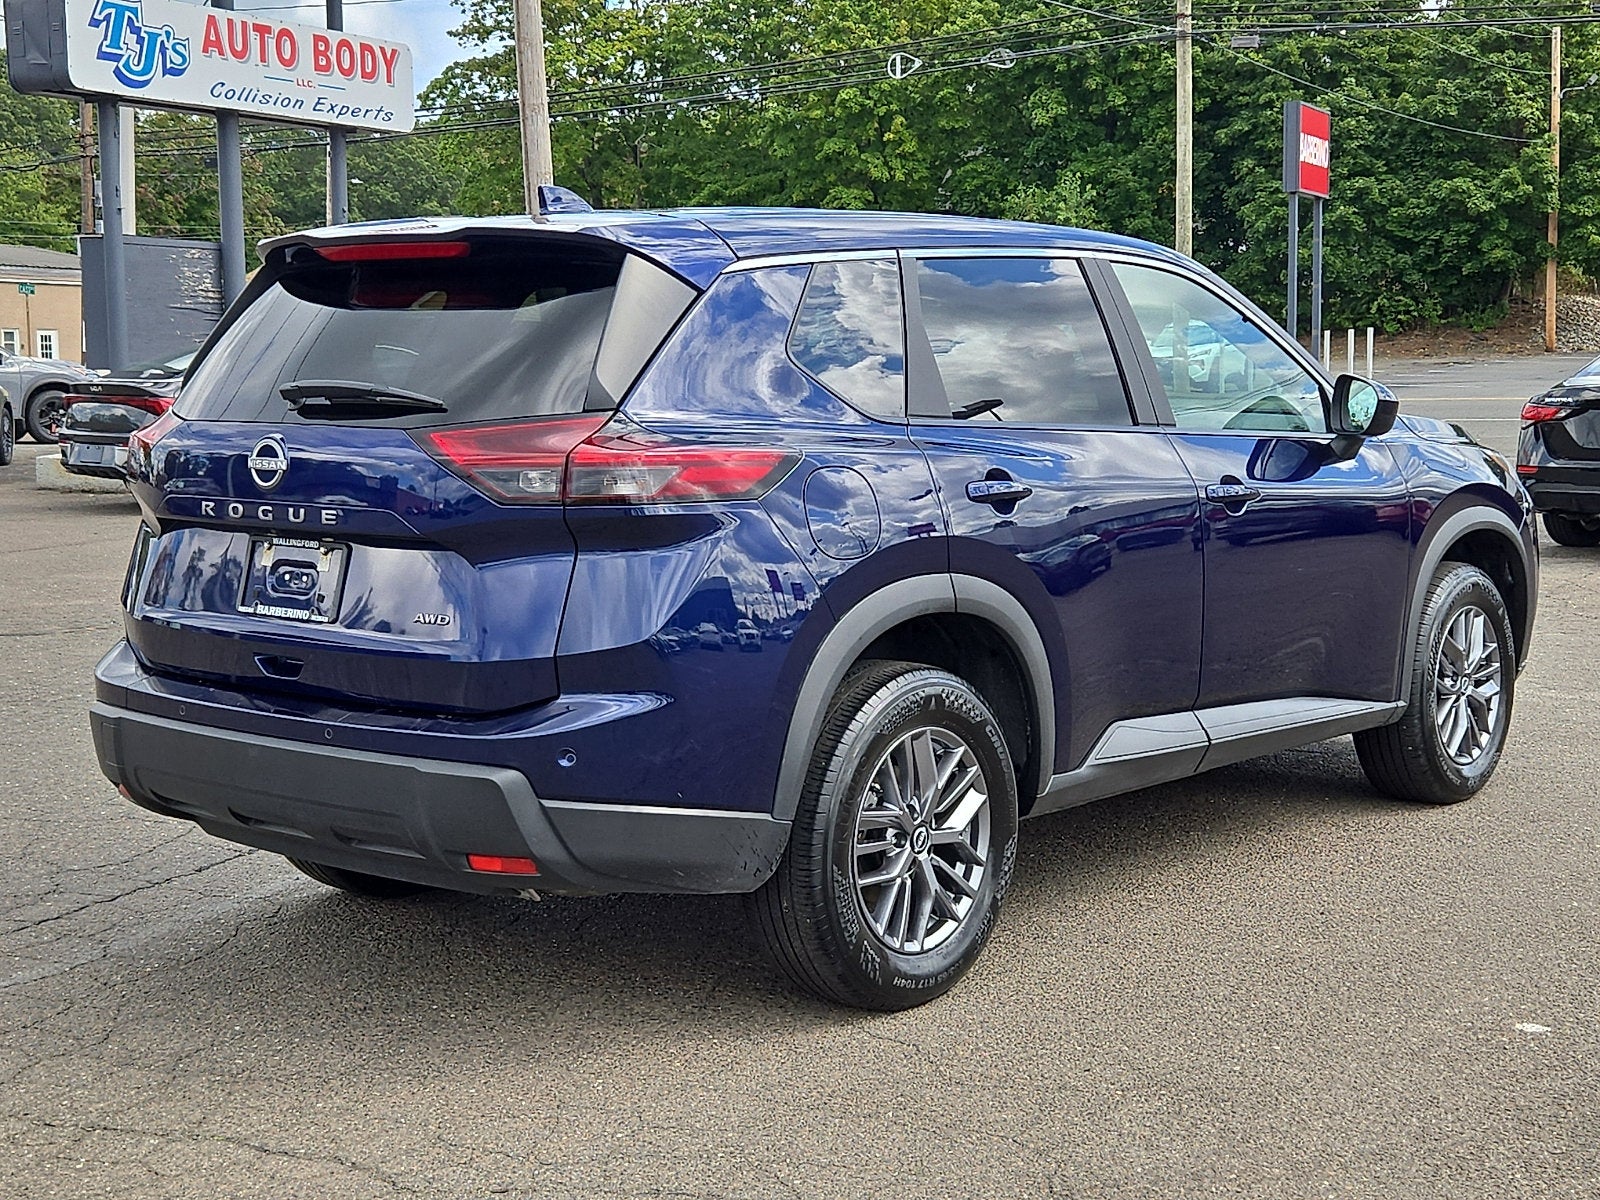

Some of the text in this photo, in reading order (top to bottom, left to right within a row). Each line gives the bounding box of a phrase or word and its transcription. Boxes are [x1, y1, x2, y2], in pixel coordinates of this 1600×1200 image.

[88, 0, 190, 88] TJ's
[201, 14, 399, 86] AUTO BODY
[296, 77, 316, 89] LLC.
[210, 81, 395, 122] Collision Experts
[249, 459, 287, 470] NISSAN
[201, 500, 339, 525] ROGUE
[272, 537, 320, 549] WALLINGFORD
[256, 604, 310, 620] BARBERINO
[413, 612, 451, 626] AWD
